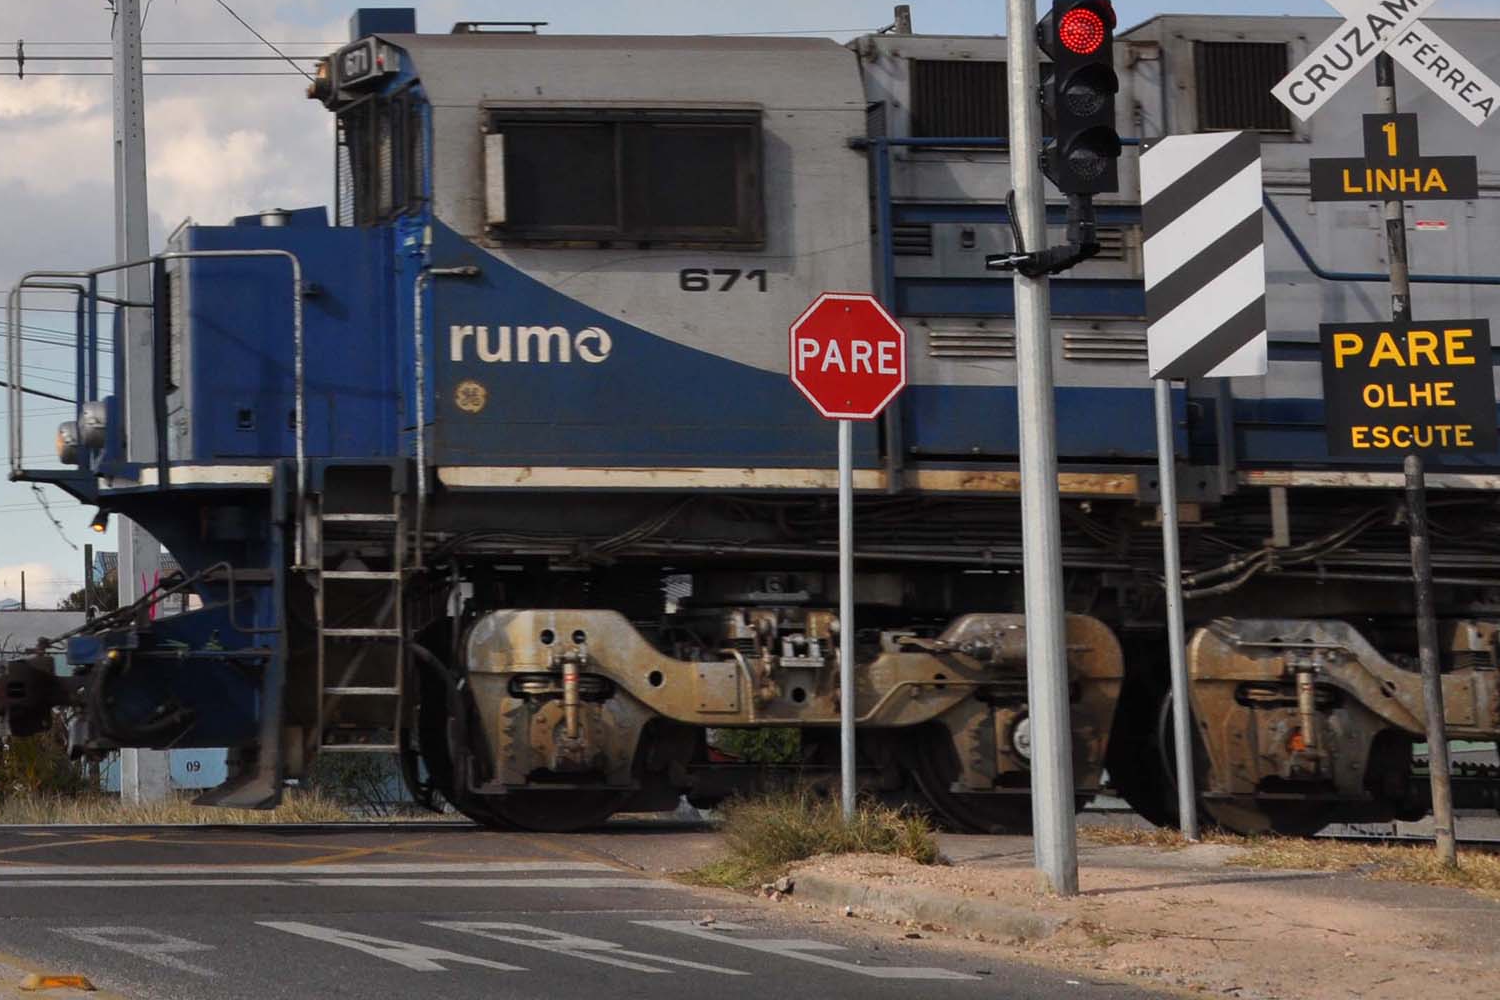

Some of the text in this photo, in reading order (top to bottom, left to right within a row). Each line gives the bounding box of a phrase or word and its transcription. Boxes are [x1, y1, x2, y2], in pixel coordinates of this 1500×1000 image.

[346, 47, 368, 76] 671
[1398, 31, 1495, 118] FÉRREA
[1382, 121, 1397, 156] 1
[1343, 168, 1448, 193] LINHA
[679, 268, 768, 292] 671
[450, 325, 612, 363] rumo
[798, 338, 898, 375] PARE
[1333, 328, 1476, 369] PARE
[1363, 382, 1456, 408] OLHE
[1351, 425, 1474, 448] ESCUTE
[186, 760, 200, 772] 09
